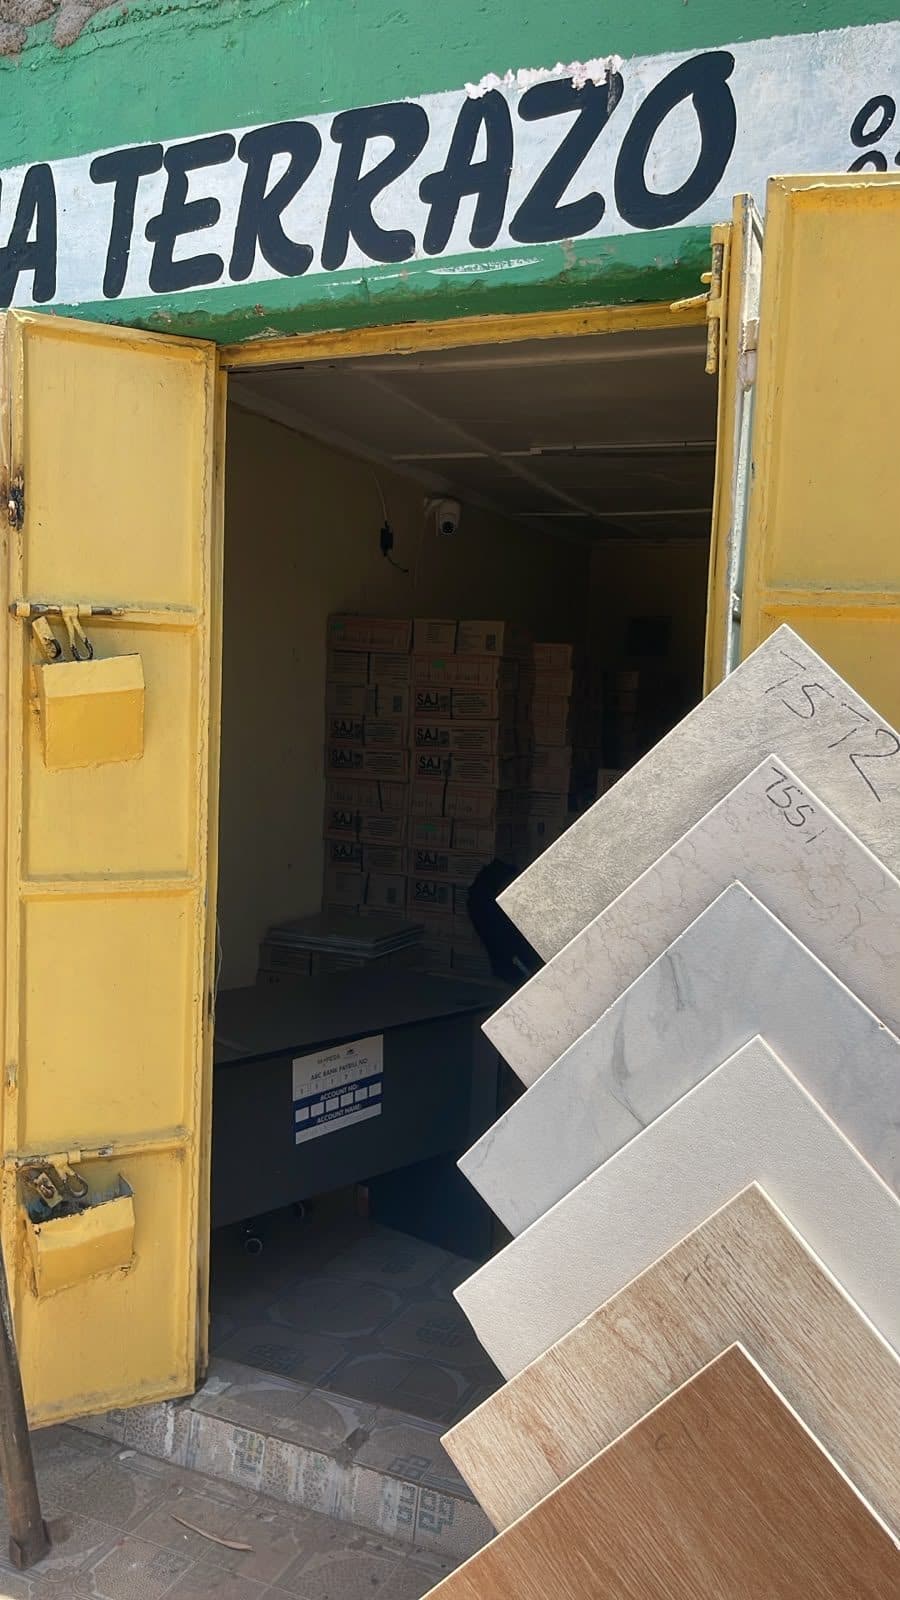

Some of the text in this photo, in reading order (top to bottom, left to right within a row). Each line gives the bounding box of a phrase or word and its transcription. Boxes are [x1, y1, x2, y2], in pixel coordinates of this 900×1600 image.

[89, 50, 736, 298] TERRAZO
[417, 693, 438, 706] SAJ
[764, 650, 900, 803] 7572
[416, 728, 438, 740] SAJ
[418, 756, 441, 769] SAJ
[417, 851, 438, 865] SAJ
[415, 882, 437, 897] SAJ
[320, 1087, 347, 1101] ACCOUNT
[316, 1109, 344, 1123] ACCOUNT
